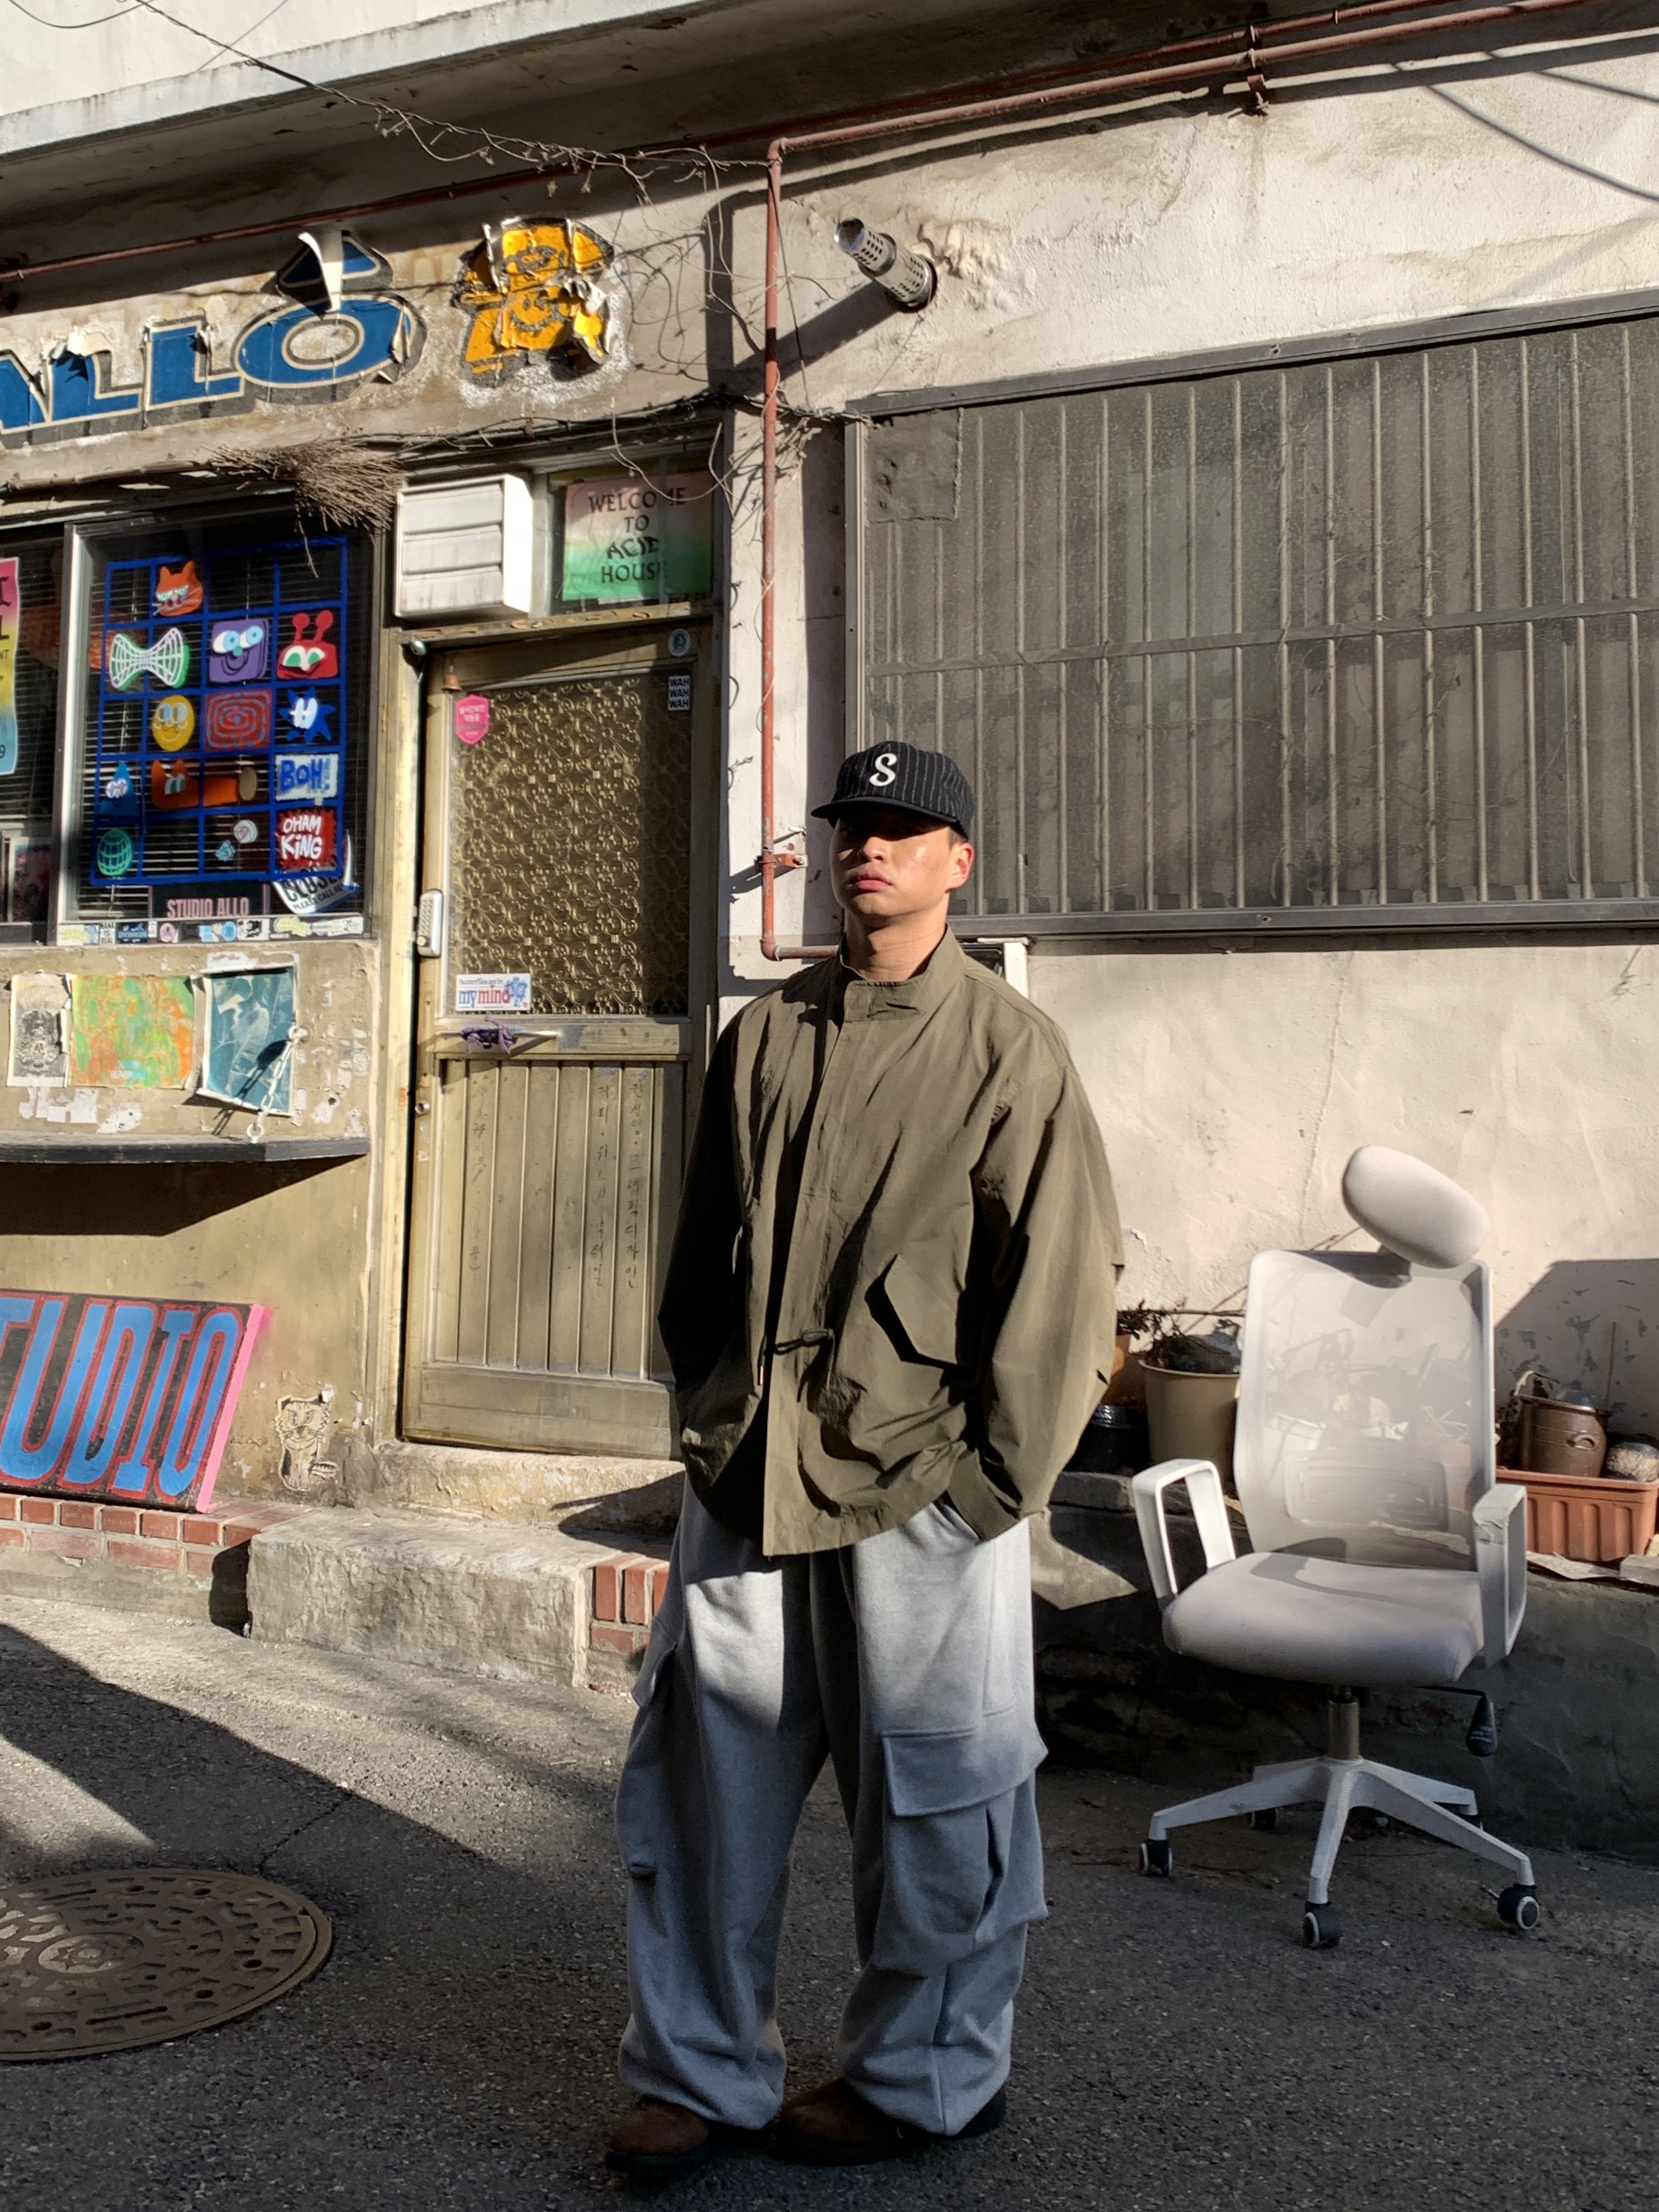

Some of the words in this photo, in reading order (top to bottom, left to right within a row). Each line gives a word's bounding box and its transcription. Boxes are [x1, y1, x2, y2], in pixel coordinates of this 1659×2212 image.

[624, 514, 650, 533] TO
[669, 688, 689, 697] WAH
[670, 678, 689, 687] WAH
[669, 699, 689, 708] WAH
[280, 758, 331, 792] BOH!
[869, 752, 897, 787] S
[283, 814, 321, 836] OHAM
[167, 898, 213, 918] STUDIO
[217, 896, 249, 917] ALLO
[459, 989, 477, 1009] my
